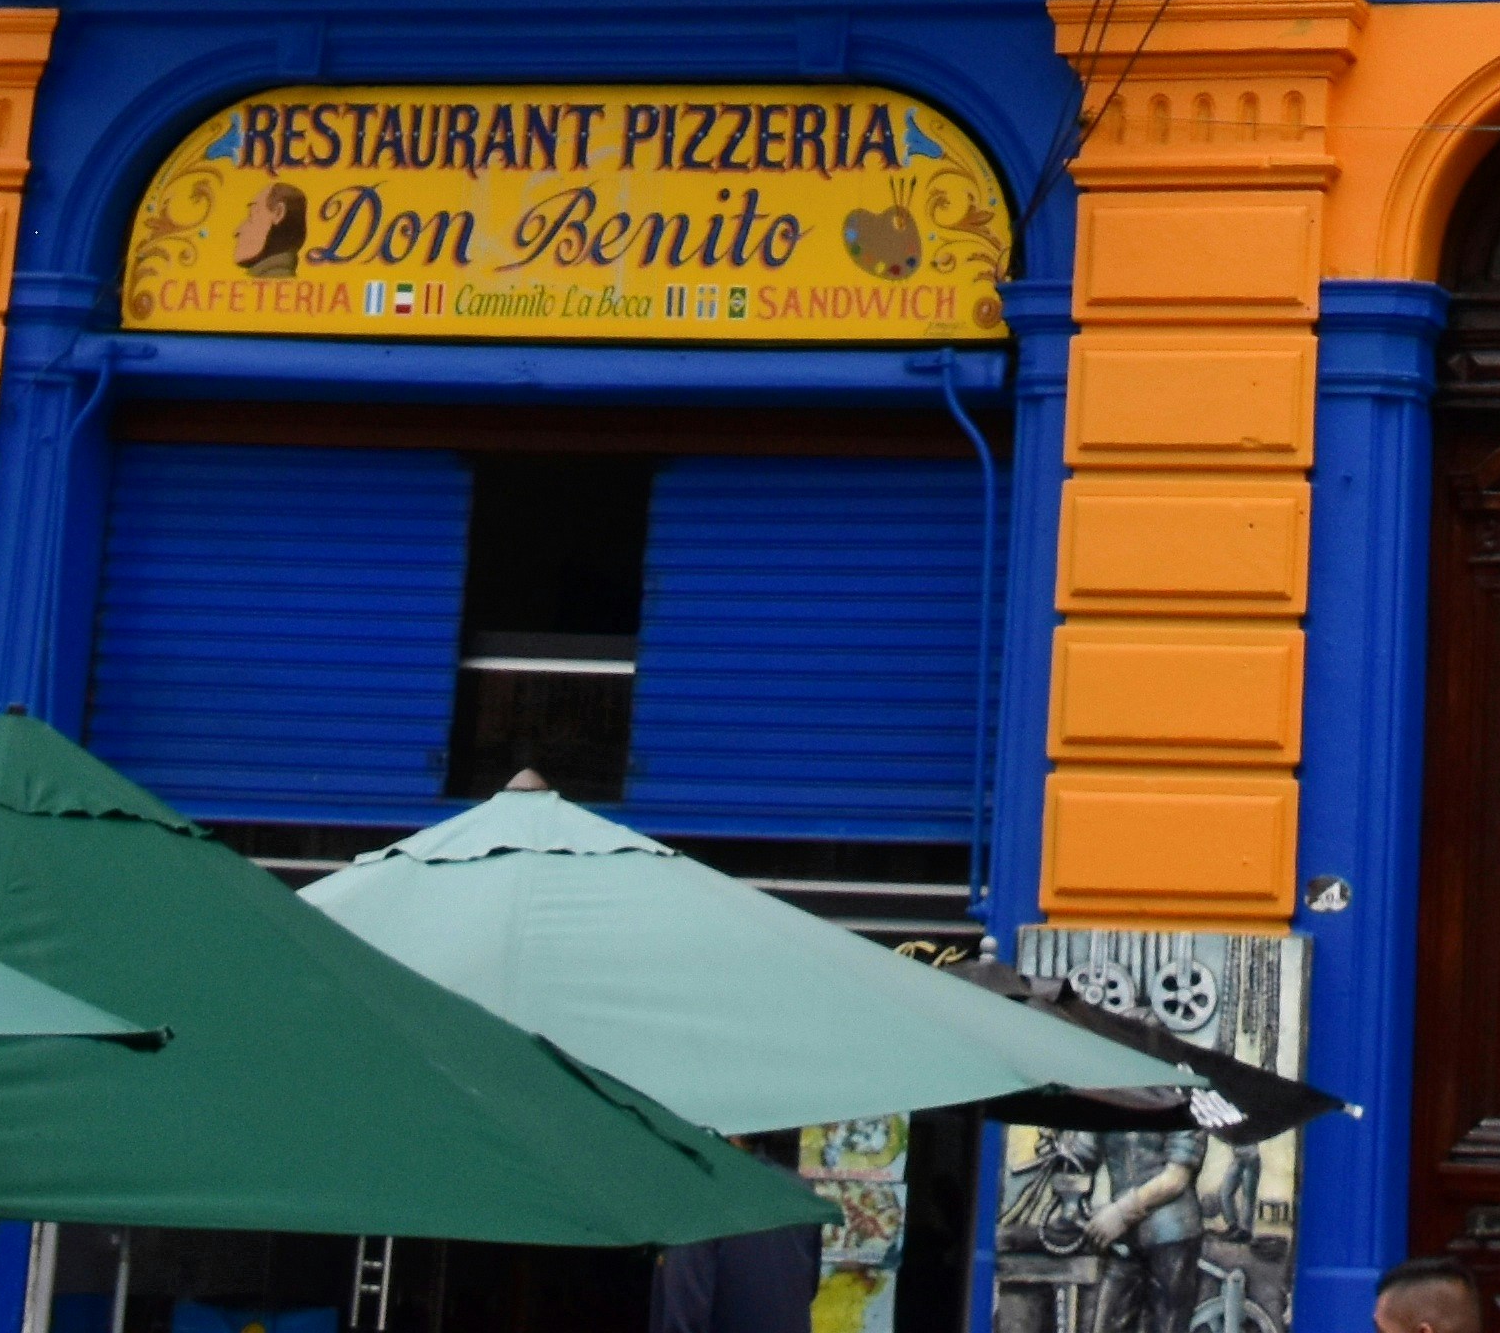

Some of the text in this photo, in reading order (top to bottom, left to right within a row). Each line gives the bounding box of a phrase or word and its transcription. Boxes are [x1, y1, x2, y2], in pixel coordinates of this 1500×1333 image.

[236, 102, 903, 181] RESTAURANT PIZZERIA
[304, 181, 815, 272] Don Benito
[158, 278, 958, 321] CAFETERIA Caminito La Boca SANDWICH
